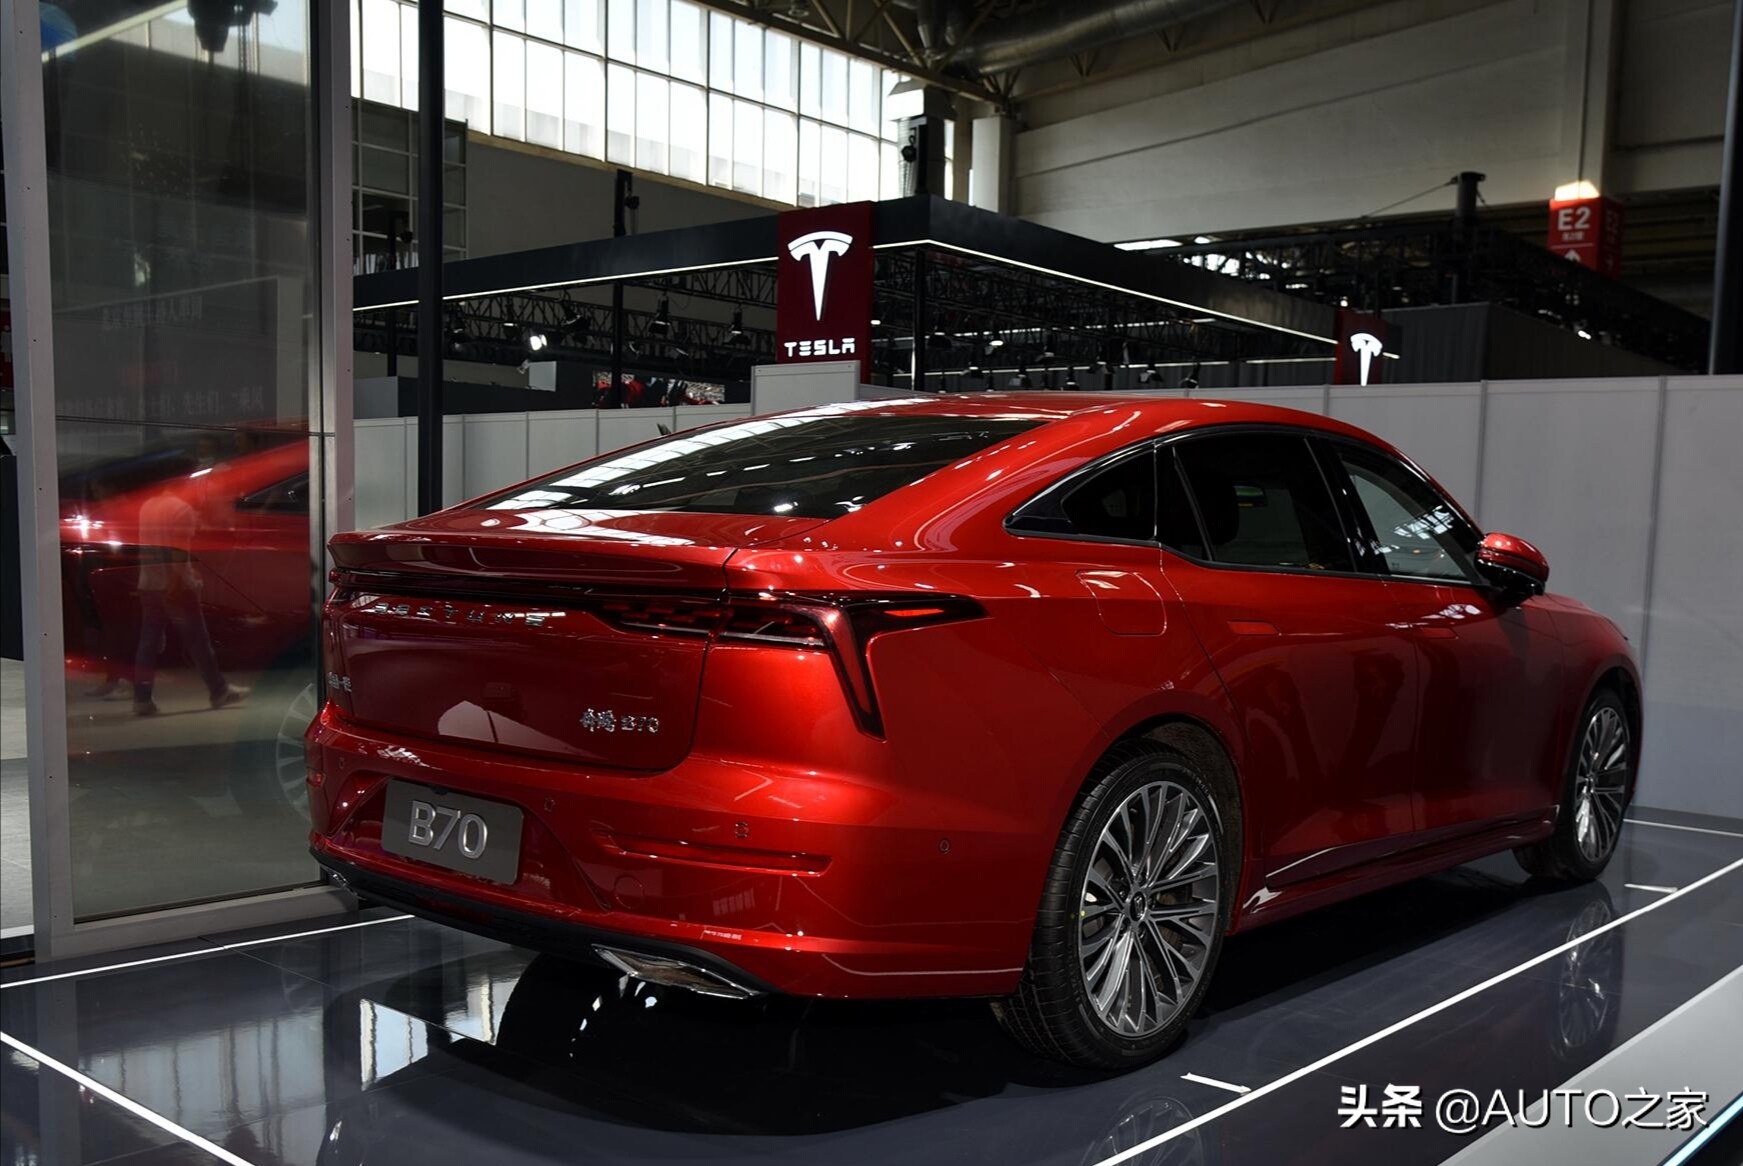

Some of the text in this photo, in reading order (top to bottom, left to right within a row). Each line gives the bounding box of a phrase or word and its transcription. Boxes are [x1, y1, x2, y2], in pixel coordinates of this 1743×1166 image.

[1557, 206, 1592, 231] E2
[783, 337, 856, 358] TESLA
[407, 800, 488, 859] B70
